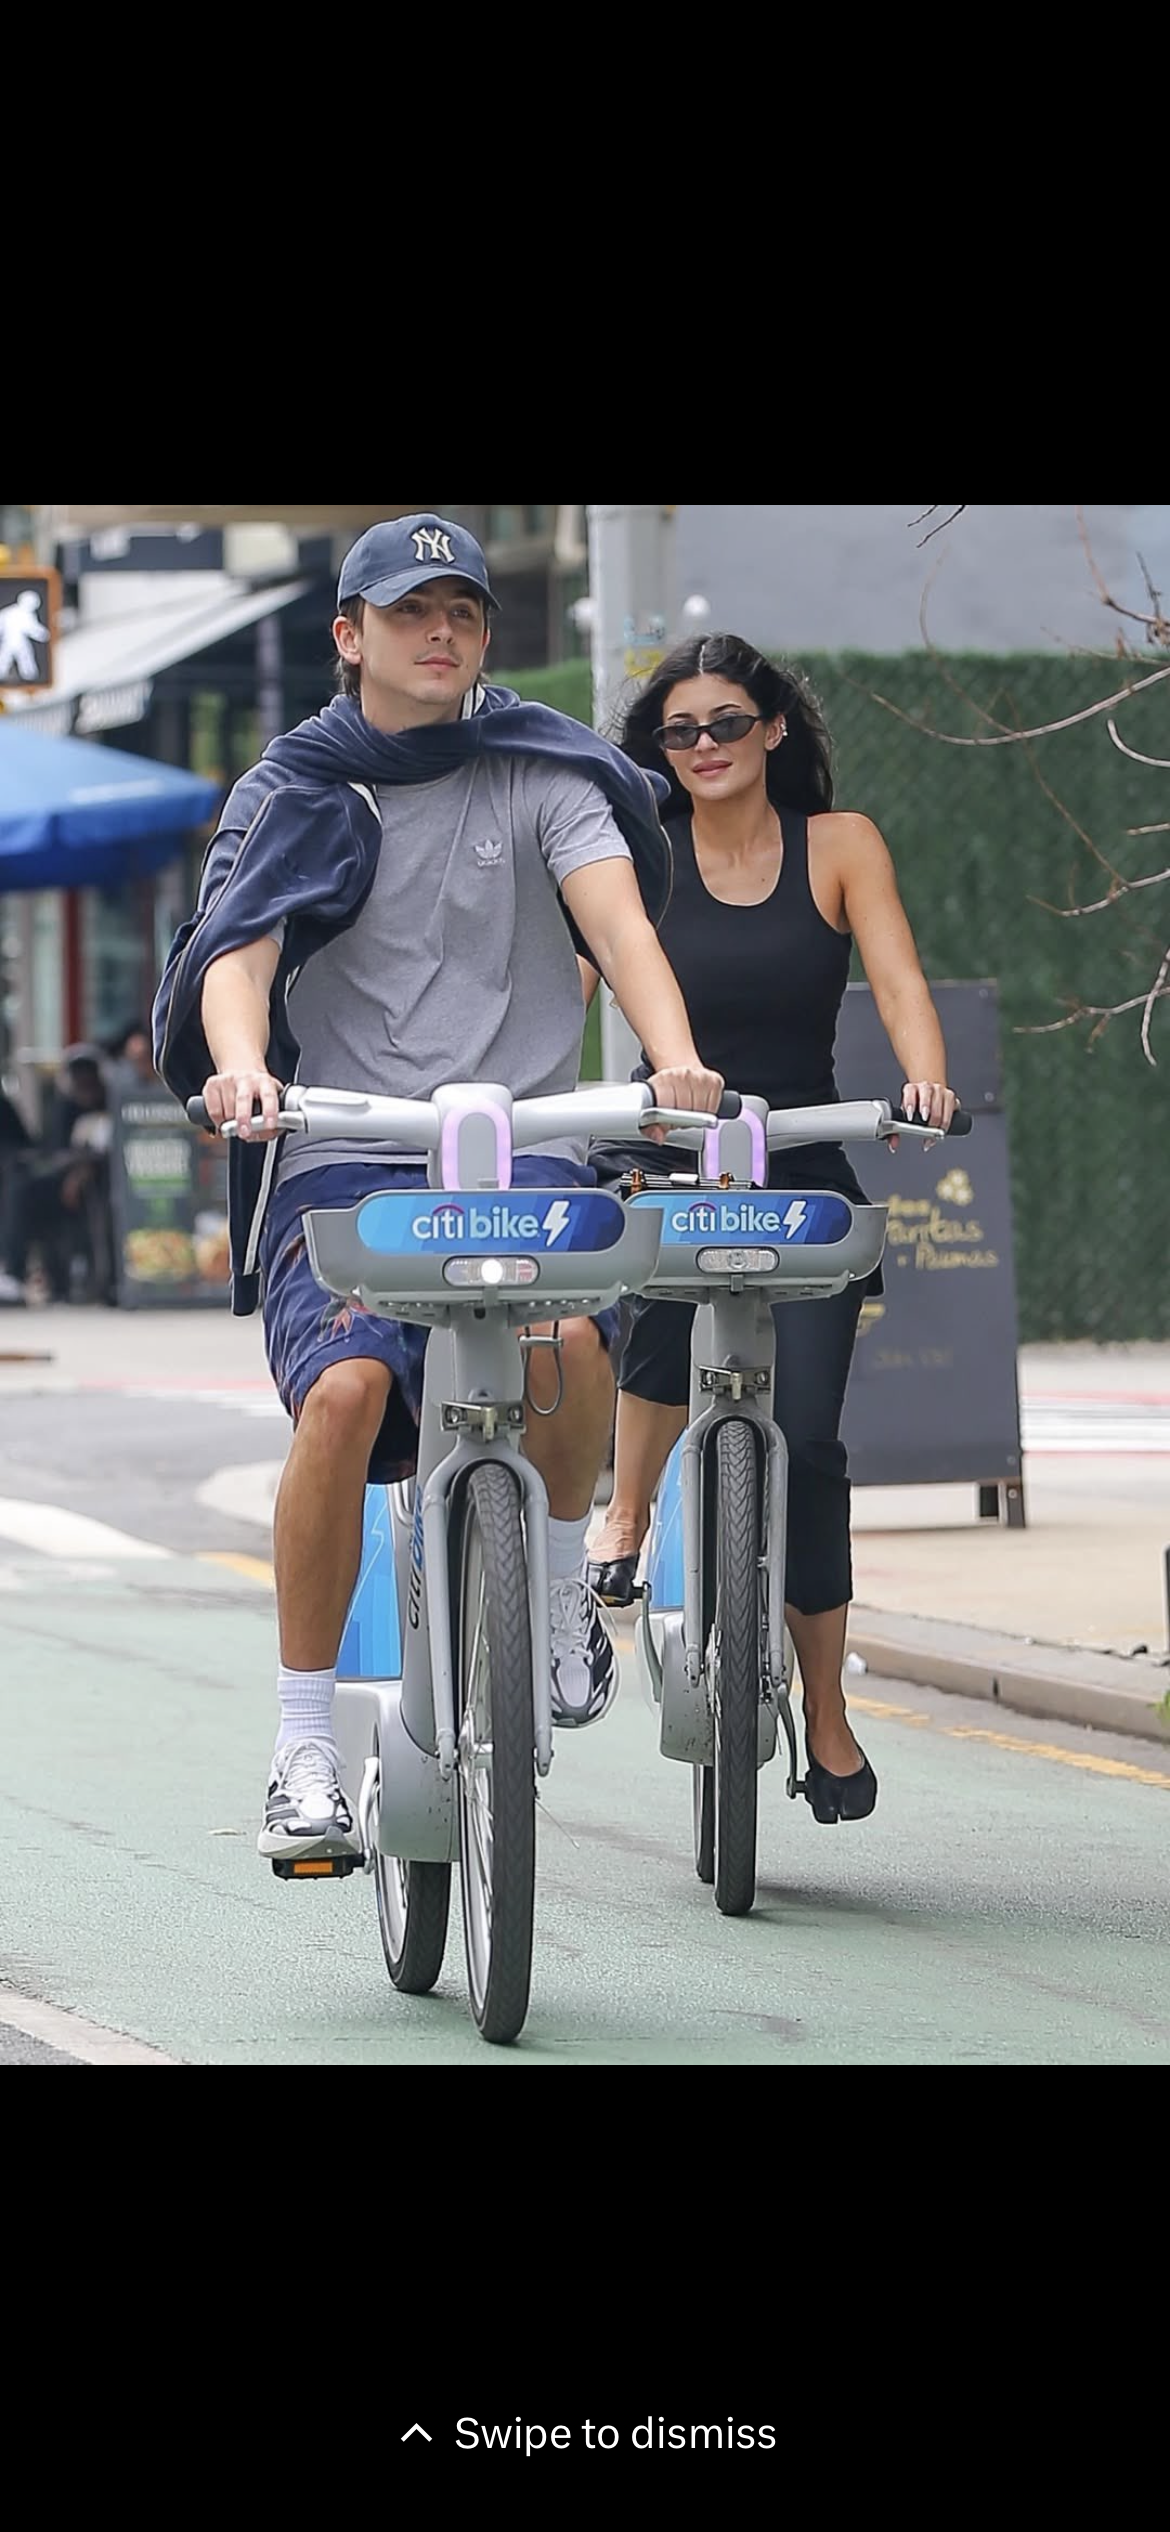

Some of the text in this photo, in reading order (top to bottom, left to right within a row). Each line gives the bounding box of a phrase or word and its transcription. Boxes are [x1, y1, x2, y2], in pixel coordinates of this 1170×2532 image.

[411, 526, 455, 563] NY
[412, 1206, 539, 1239] citi bike
[671, 1204, 780, 1232] citi bike
